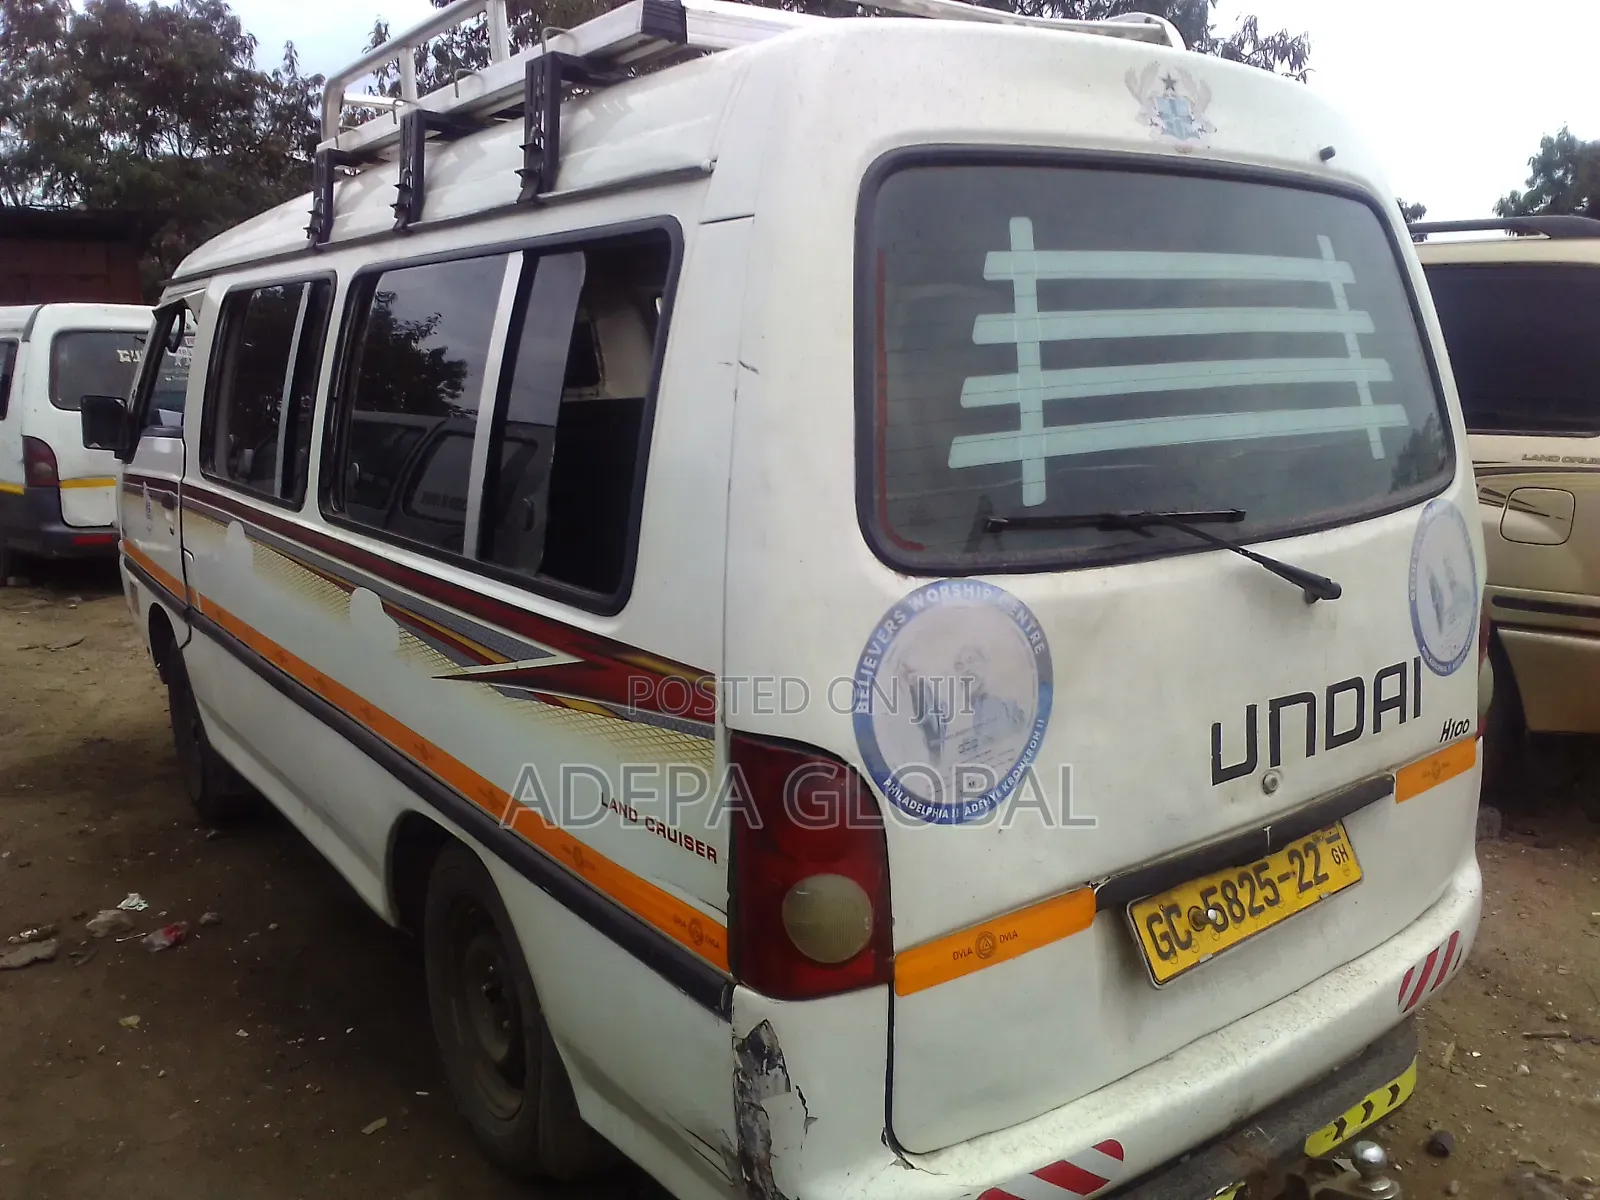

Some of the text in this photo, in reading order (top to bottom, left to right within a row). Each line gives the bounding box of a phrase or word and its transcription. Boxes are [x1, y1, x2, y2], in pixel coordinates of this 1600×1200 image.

[1521, 453, 1560, 463] LAND
[856, 609, 906, 714] BELIEVERS
[907, 584, 993, 612] WORSHIP
[1211, 656, 1421, 785] UNDAI
[1438, 717, 1470, 743] H100
[882, 778, 949, 819] PHILADELPHIA
[601, 792, 718, 865] LAND CRUISER
[1331, 843, 1349, 865] GH
[1146, 841, 1330, 961] GC 5825-22
[952, 929, 1019, 961] DVLA DVLA
